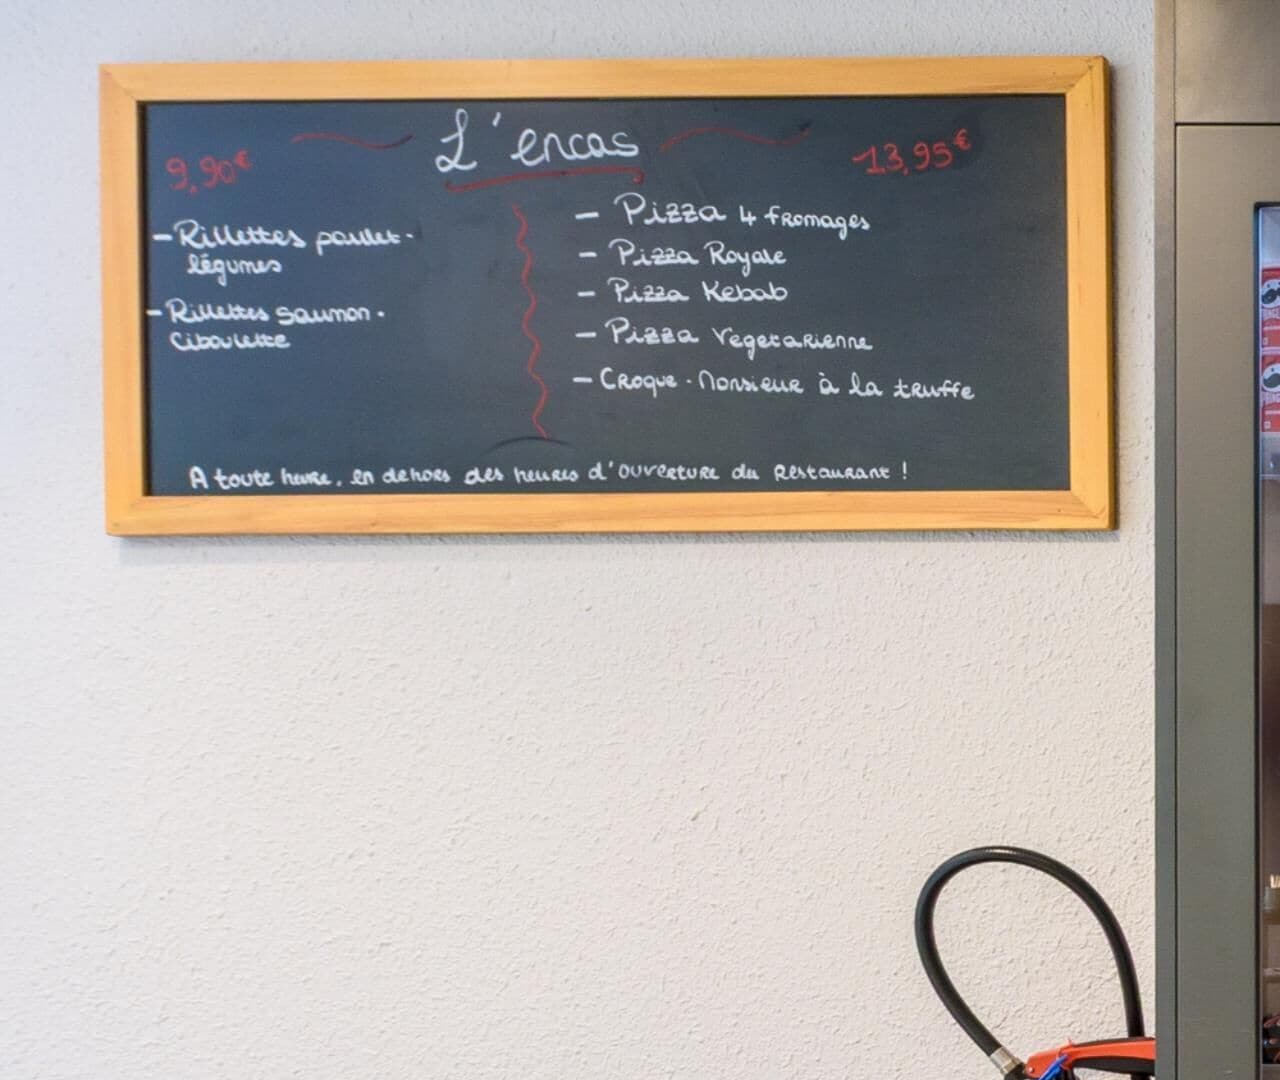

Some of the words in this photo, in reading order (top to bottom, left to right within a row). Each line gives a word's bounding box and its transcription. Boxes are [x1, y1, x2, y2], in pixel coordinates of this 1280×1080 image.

[613, 191, 728, 227] Pizza
[738, 204, 757, 227] 4
[607, 238, 699, 267] Pizza
[703, 239, 787, 278] Royale
[606, 276, 690, 304] Pizza
[701, 279, 789, 303] Kebab
[604, 316, 700, 346] Pizza
[848, 371, 884, 396] la
[892, 377, 976, 401] truffe
[213, 467, 275, 490] toute
[349, 466, 376, 487] en
[381, 465, 452, 485] dehors
[463, 464, 506, 486] des
[513, 464, 580, 485] heures
[730, 462, 761, 481] du
